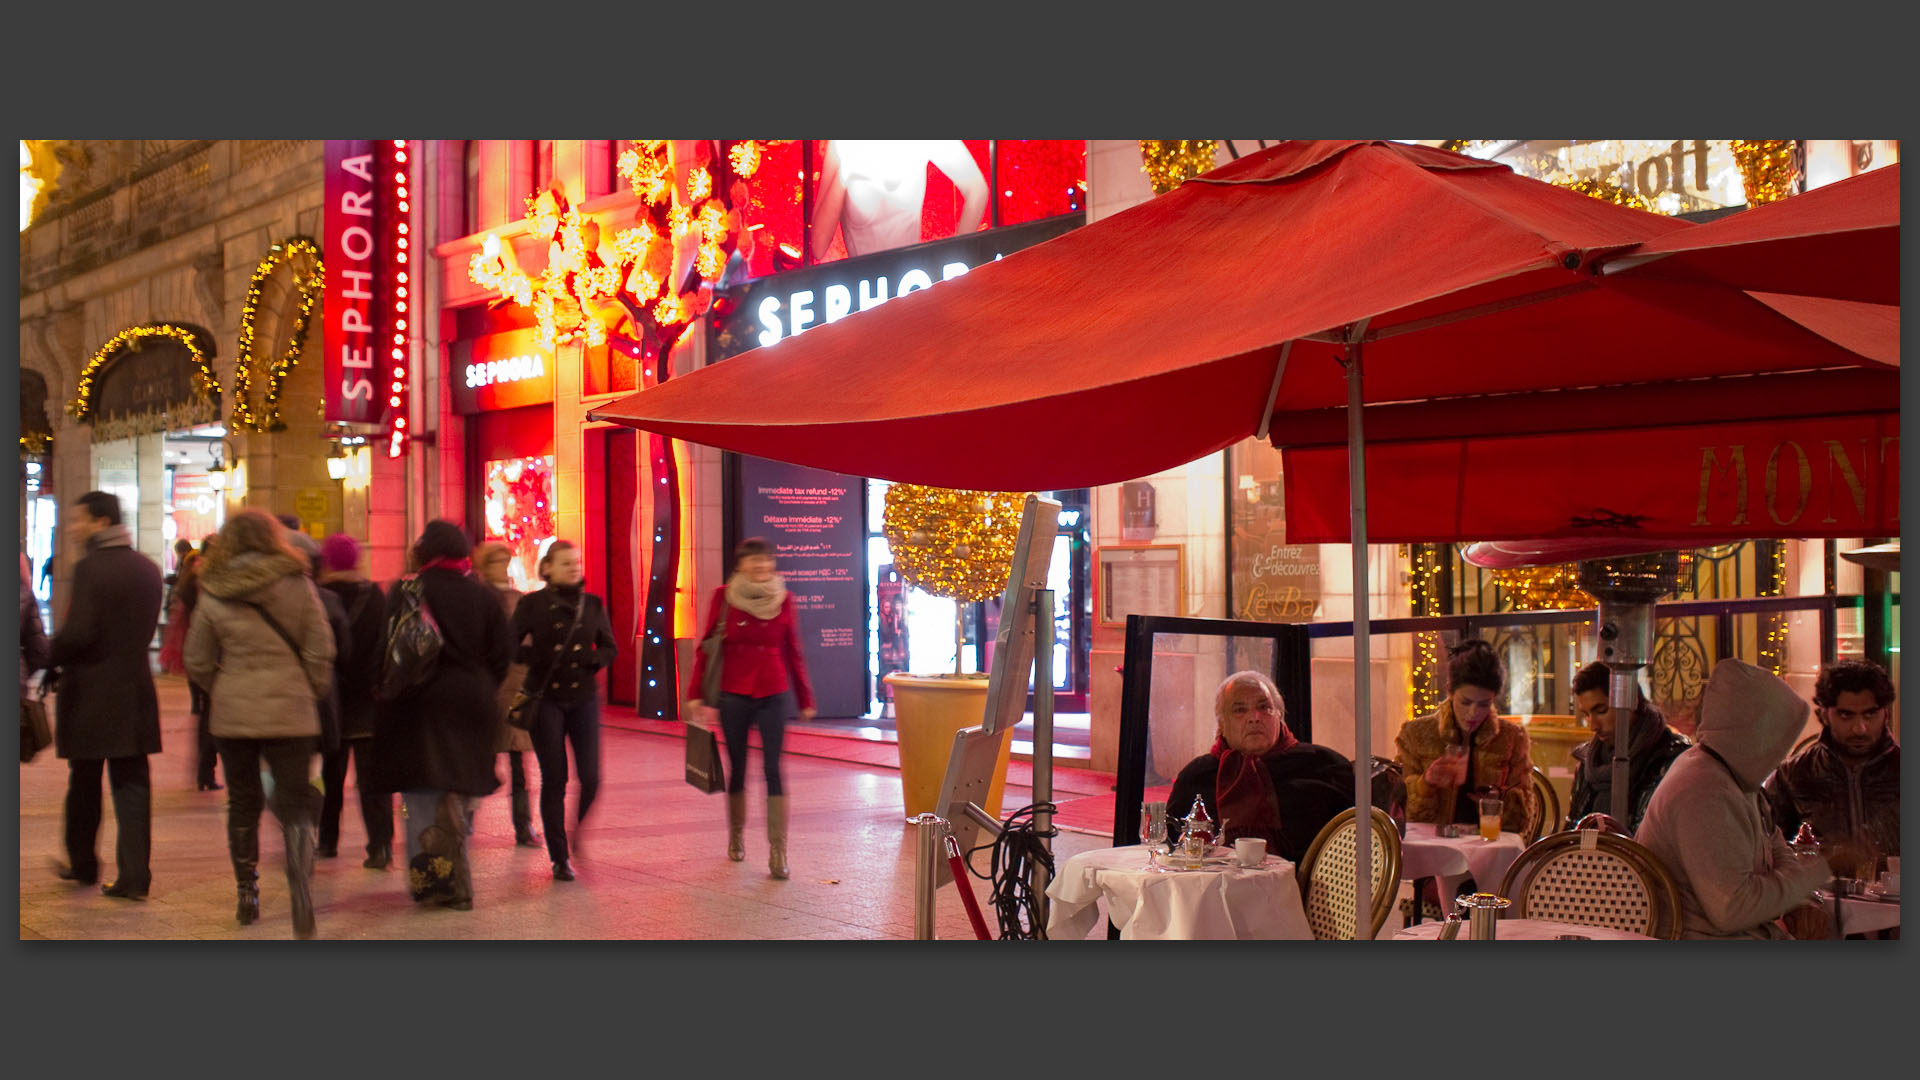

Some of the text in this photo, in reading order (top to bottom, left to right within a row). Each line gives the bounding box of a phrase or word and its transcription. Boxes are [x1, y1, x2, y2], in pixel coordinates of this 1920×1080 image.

[340, 154, 373, 401] SEPHORA
[758, 254, 1003, 347] SEPHO
[466, 354, 544, 388] SEPHORA
[758, 487, 793, 495] Immediate
[806, 487, 827, 495] refund
[1137, 491, 1150, 508] H
[763, 515, 787, 523] Détaxe
[789, 515, 823, 523] immédiate
[1271, 545, 1302, 559] Entrez
[1271, 561, 1320, 576] découvrez
[1241, 582, 1269, 621] Le
